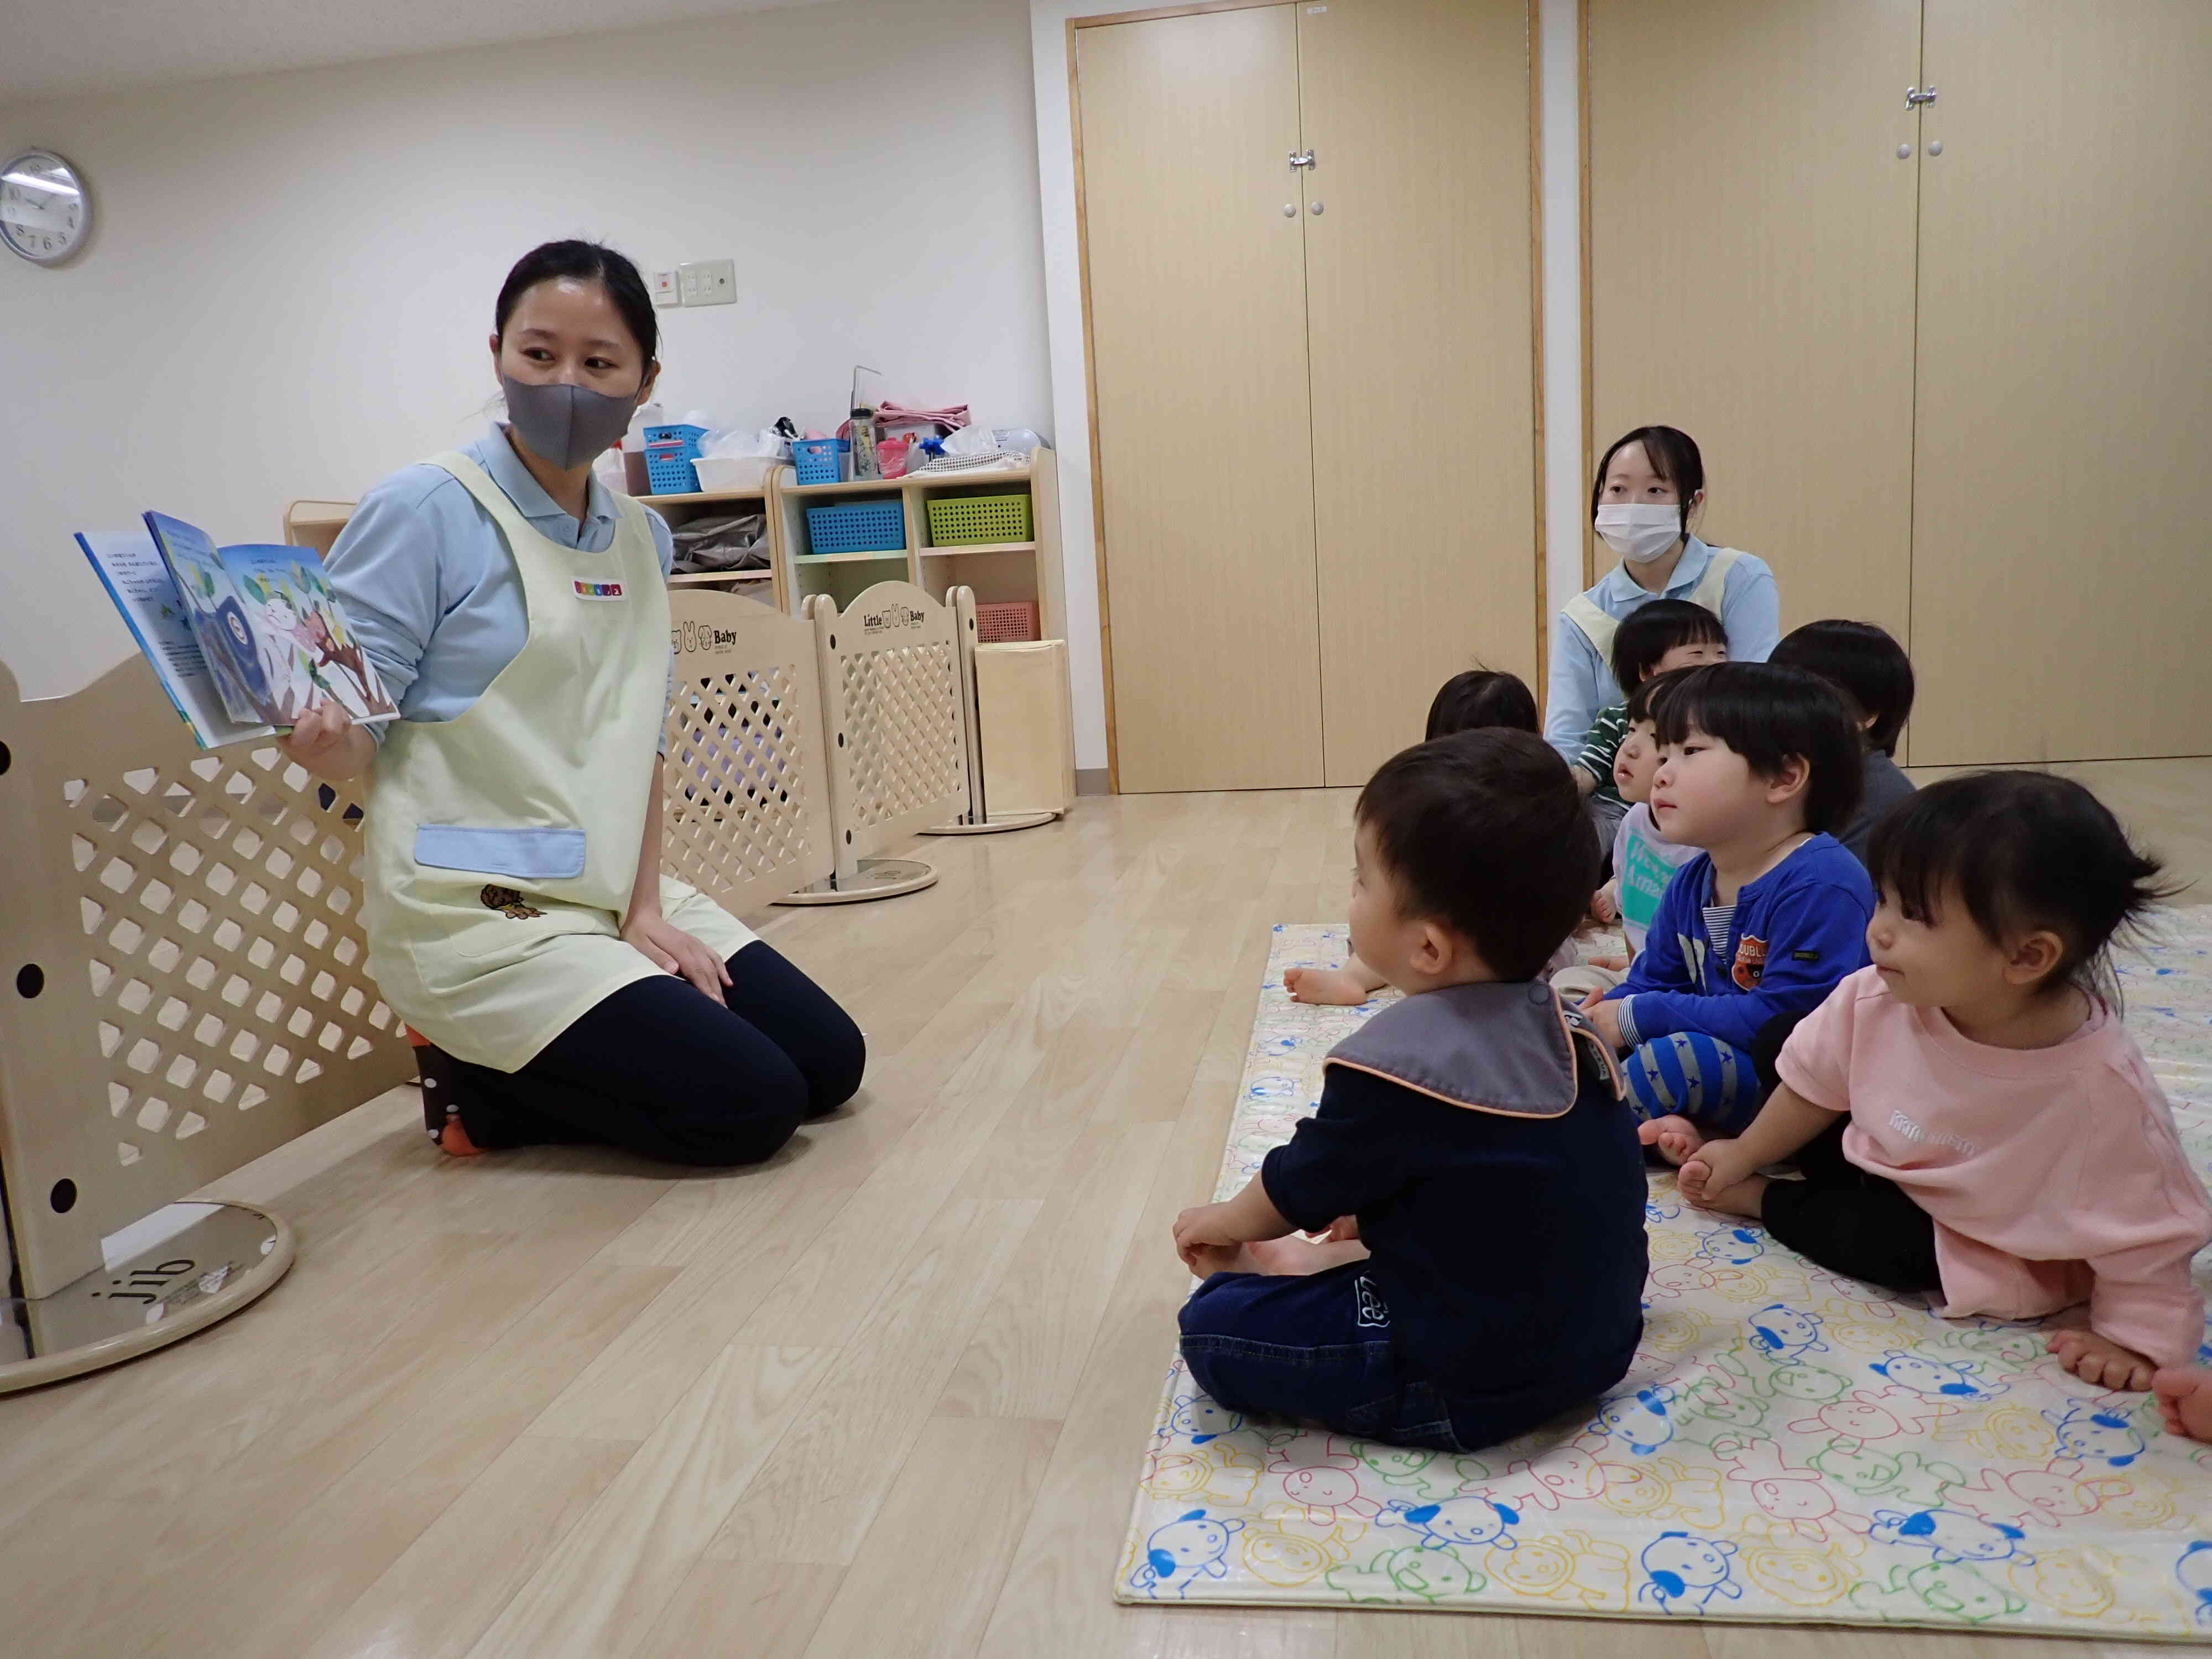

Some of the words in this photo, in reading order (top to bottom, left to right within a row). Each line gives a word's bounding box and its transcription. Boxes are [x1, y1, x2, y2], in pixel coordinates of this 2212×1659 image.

[864, 614, 883, 627] Little
[910, 611, 925, 623] Baby
[714, 629, 737, 645] Baby
[1740, 943, 1767, 957] OUBL
